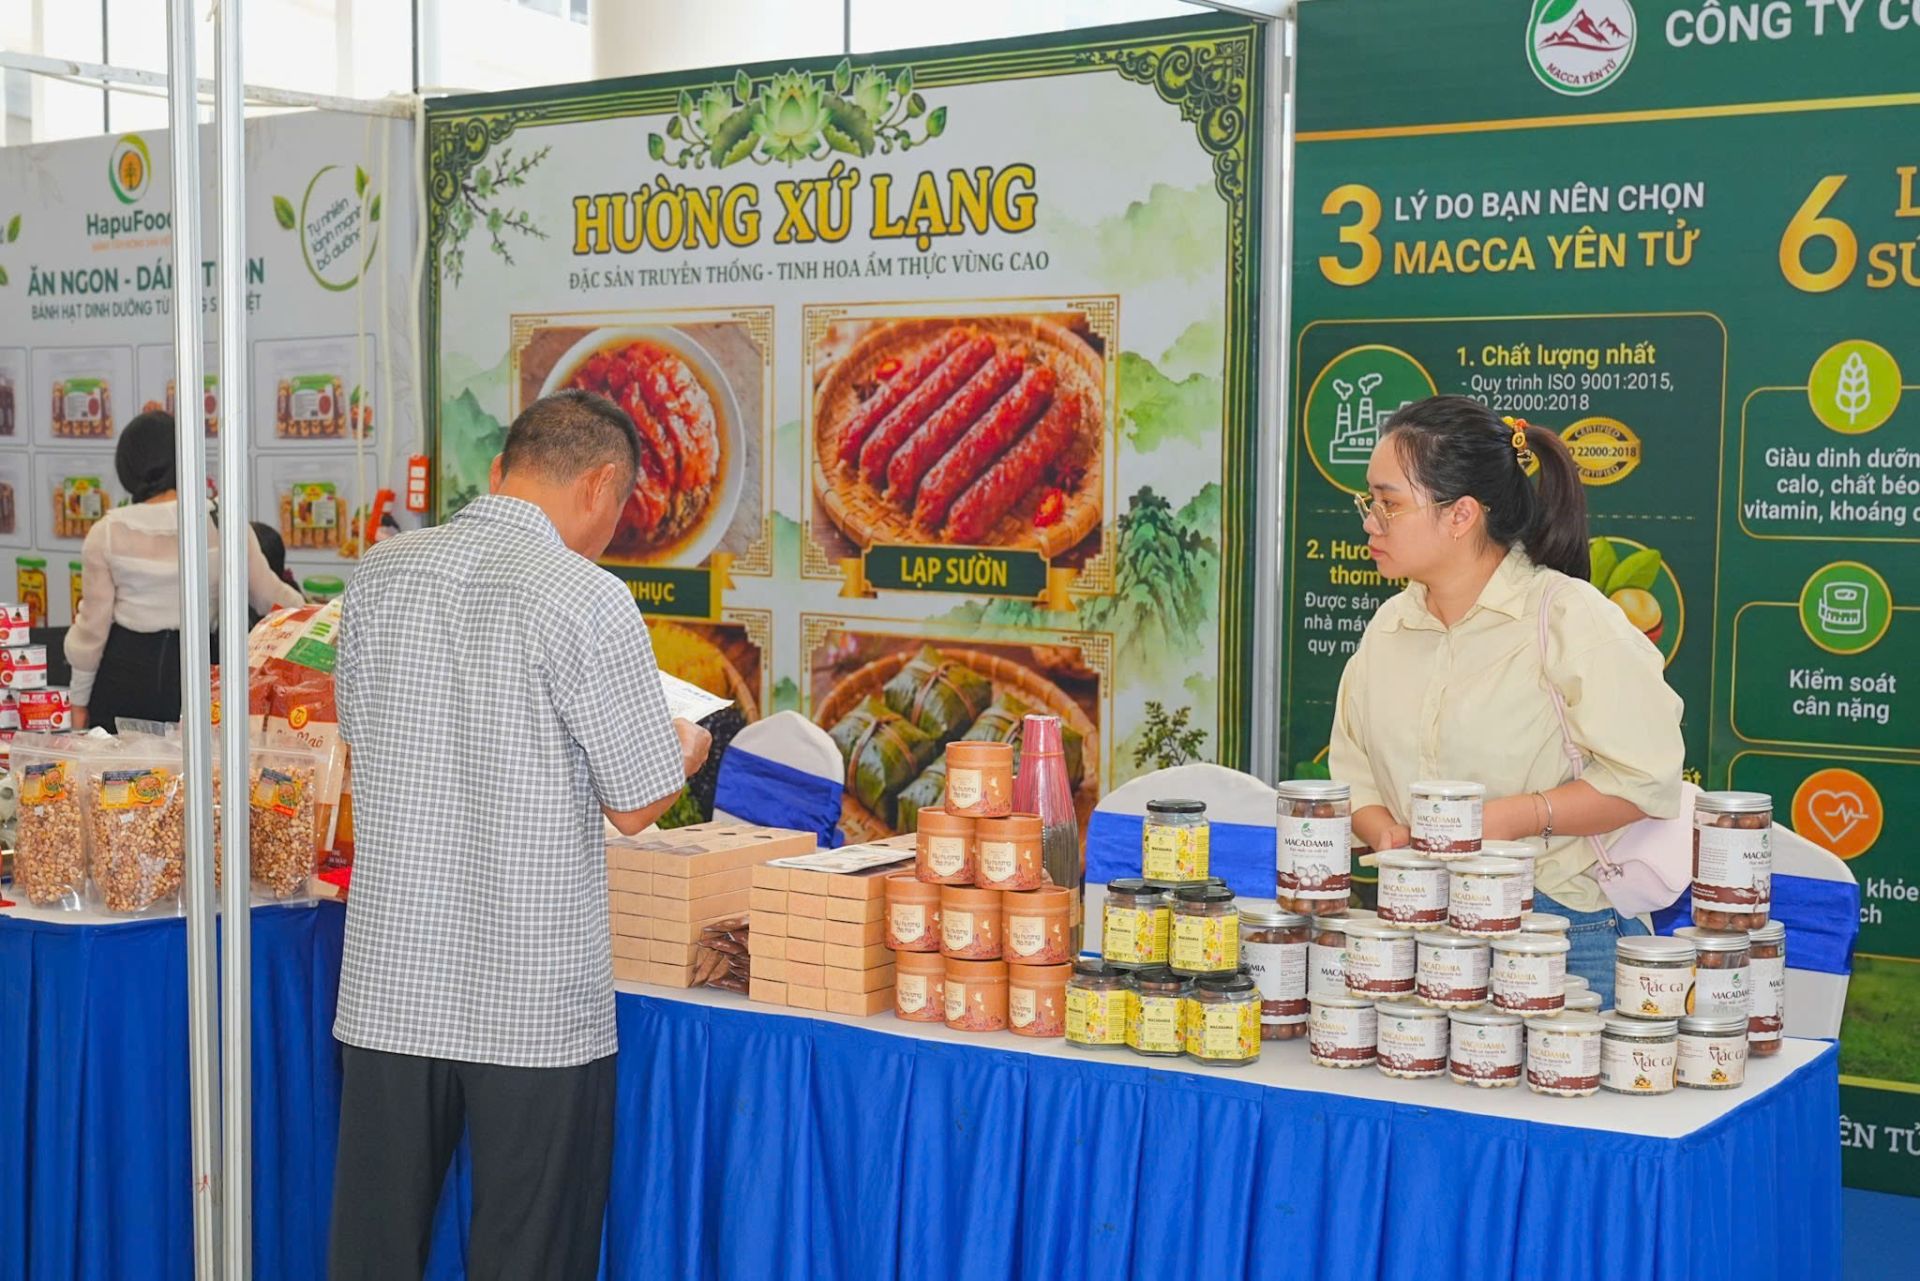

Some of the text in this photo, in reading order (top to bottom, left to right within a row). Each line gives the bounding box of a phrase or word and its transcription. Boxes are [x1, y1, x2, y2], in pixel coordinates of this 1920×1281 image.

[1665, 0, 1920, 47] CÔNG TY C
[1547, 62, 1580, 84] MACCA
[1582, 70, 1604, 84] YÊN
[774, 160, 861, 245] XỨ
[869, 163, 1037, 252] LẠNG
[1394, 181, 1705, 222] LÝ DO BẠN NÊN CHỌN
[334, 205, 362, 237] mạn
[1779, 174, 1858, 293] 6
[332, 228, 361, 259] dưỡn
[1318, 183, 1383, 287] 3
[1393, 218, 1701, 275] MACCA YÊN TỬ
[28, 265, 55, 296] ĂN
[60, 268, 119, 296] NGON
[137, 257, 173, 291] DÁ
[569, 267, 600, 293] ĐẶC
[604, 264, 635, 288] SẢN
[638, 260, 702, 288] TRUYỀN
[706, 258, 764, 284] THỐNG
[777, 261, 818, 280] TINH
[822, 258, 861, 279] HOA
[897, 254, 946, 280] THỰC
[952, 249, 1004, 274] VÙNG
[1009, 251, 1050, 272] CAO
[85, 302, 110, 319] DINH
[1457, 341, 1656, 370] 1. Chất lượng nhất
[1471, 374, 1501, 394] Quy
[1506, 373, 1543, 391] trình
[1548, 373, 1576, 391] ISO
[1580, 372, 1674, 392] 9001:2015,
[1493, 393, 1590, 411] 22000:2018
[1574, 424, 1620, 438] CERTIFIED
[1577, 446, 1637, 457] 22000:2018
[1765, 446, 1811, 468] Giàu
[1816, 447, 1861, 468] dinh
[1776, 473, 1824, 498] calo,
[1831, 472, 1876, 494] chất
[1744, 499, 1824, 524] vitamin,
[1830, 500, 1907, 527] khoáng
[1306, 539, 1325, 560] 2.
[900, 554, 1007, 592] LẠP SƯỜN
[1330, 564, 1381, 586] thơm
[626, 580, 675, 607] NHỤC
[1304, 591, 1380, 612] Được sản
[1304, 613, 1333, 631] nhà
[1308, 639, 1336, 656] quy
[1789, 667, 1896, 693] Kiểm soát
[1792, 695, 1890, 725] cân nặng
[1284, 838, 1334, 848] MACADAMIA
[1867, 877, 1919, 902] khỏe
[1859, 904, 1882, 924] ch
[1321, 967, 1345, 977] MACA
[1840, 1114, 1877, 1150] ÊN
